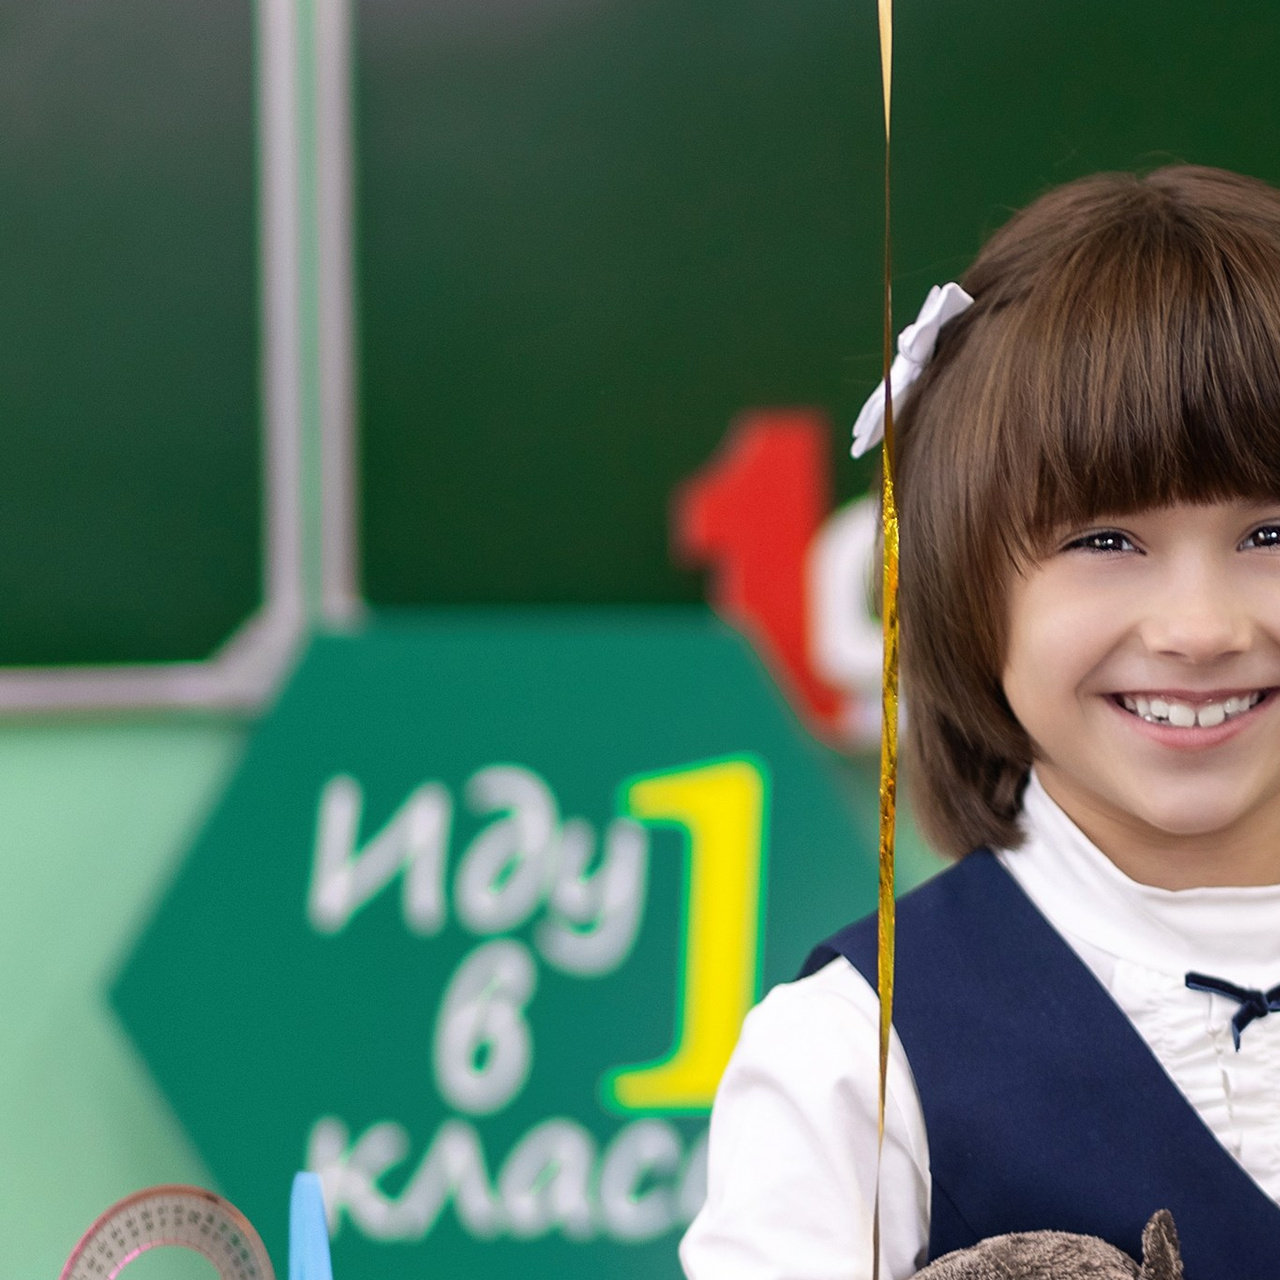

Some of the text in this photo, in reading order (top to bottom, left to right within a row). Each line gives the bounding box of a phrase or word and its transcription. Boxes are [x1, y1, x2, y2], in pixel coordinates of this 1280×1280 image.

[305, 764, 651, 977] Иду
[432, 753, 770, 1115] в 1
